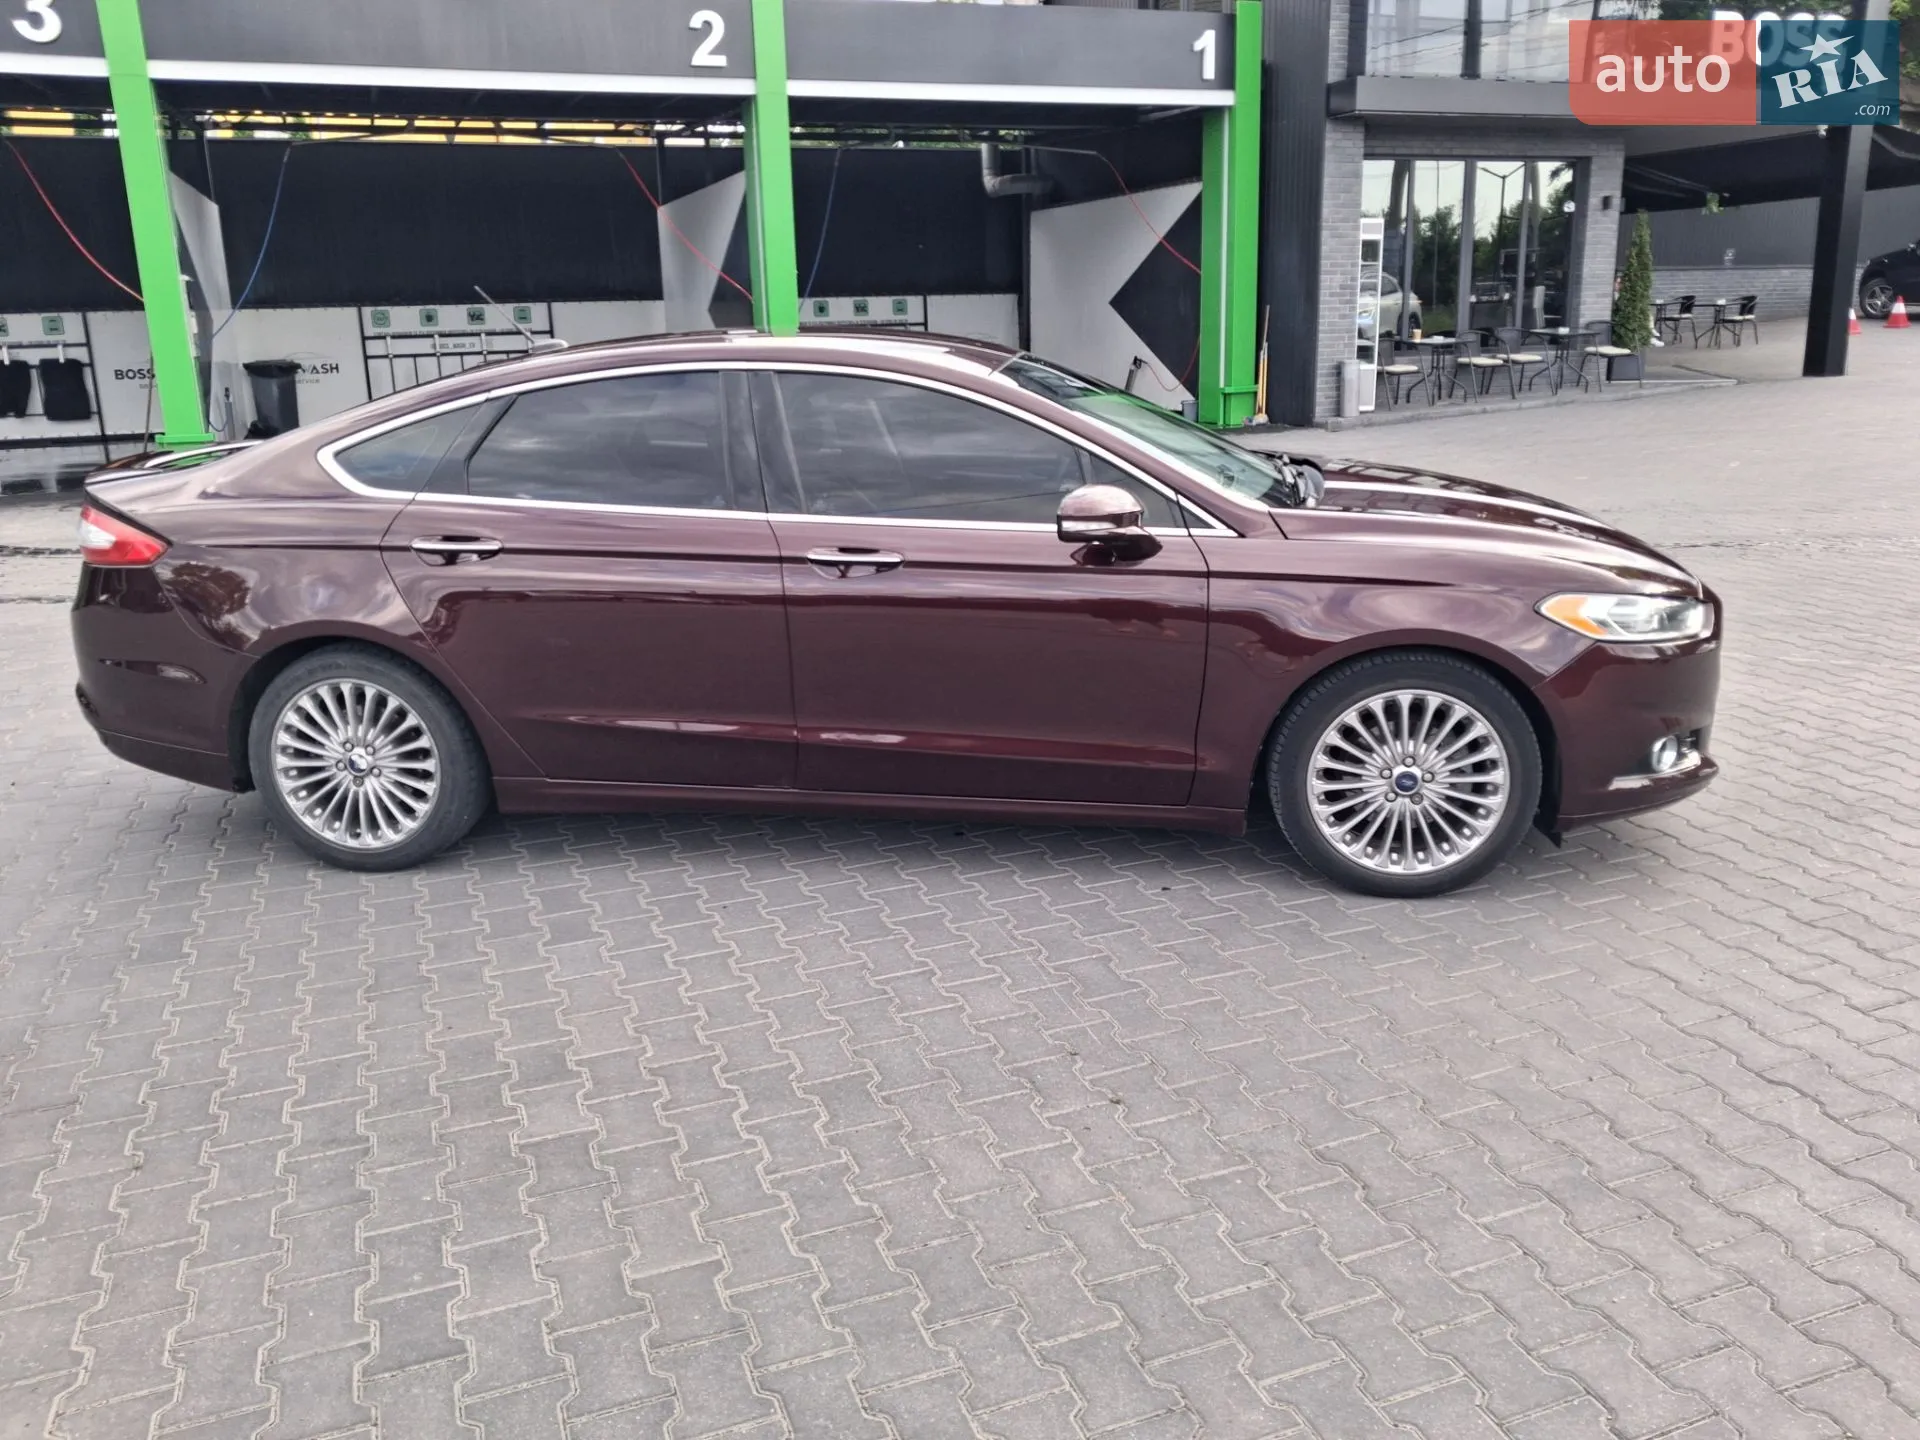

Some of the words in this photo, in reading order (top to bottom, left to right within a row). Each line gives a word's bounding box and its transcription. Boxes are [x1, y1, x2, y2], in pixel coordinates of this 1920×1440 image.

[12, 0, 62, 43] 3
[689, 9, 727, 67] 2
[1193, 29, 1216, 80] 1
[114, 368, 156, 381] BOSS
